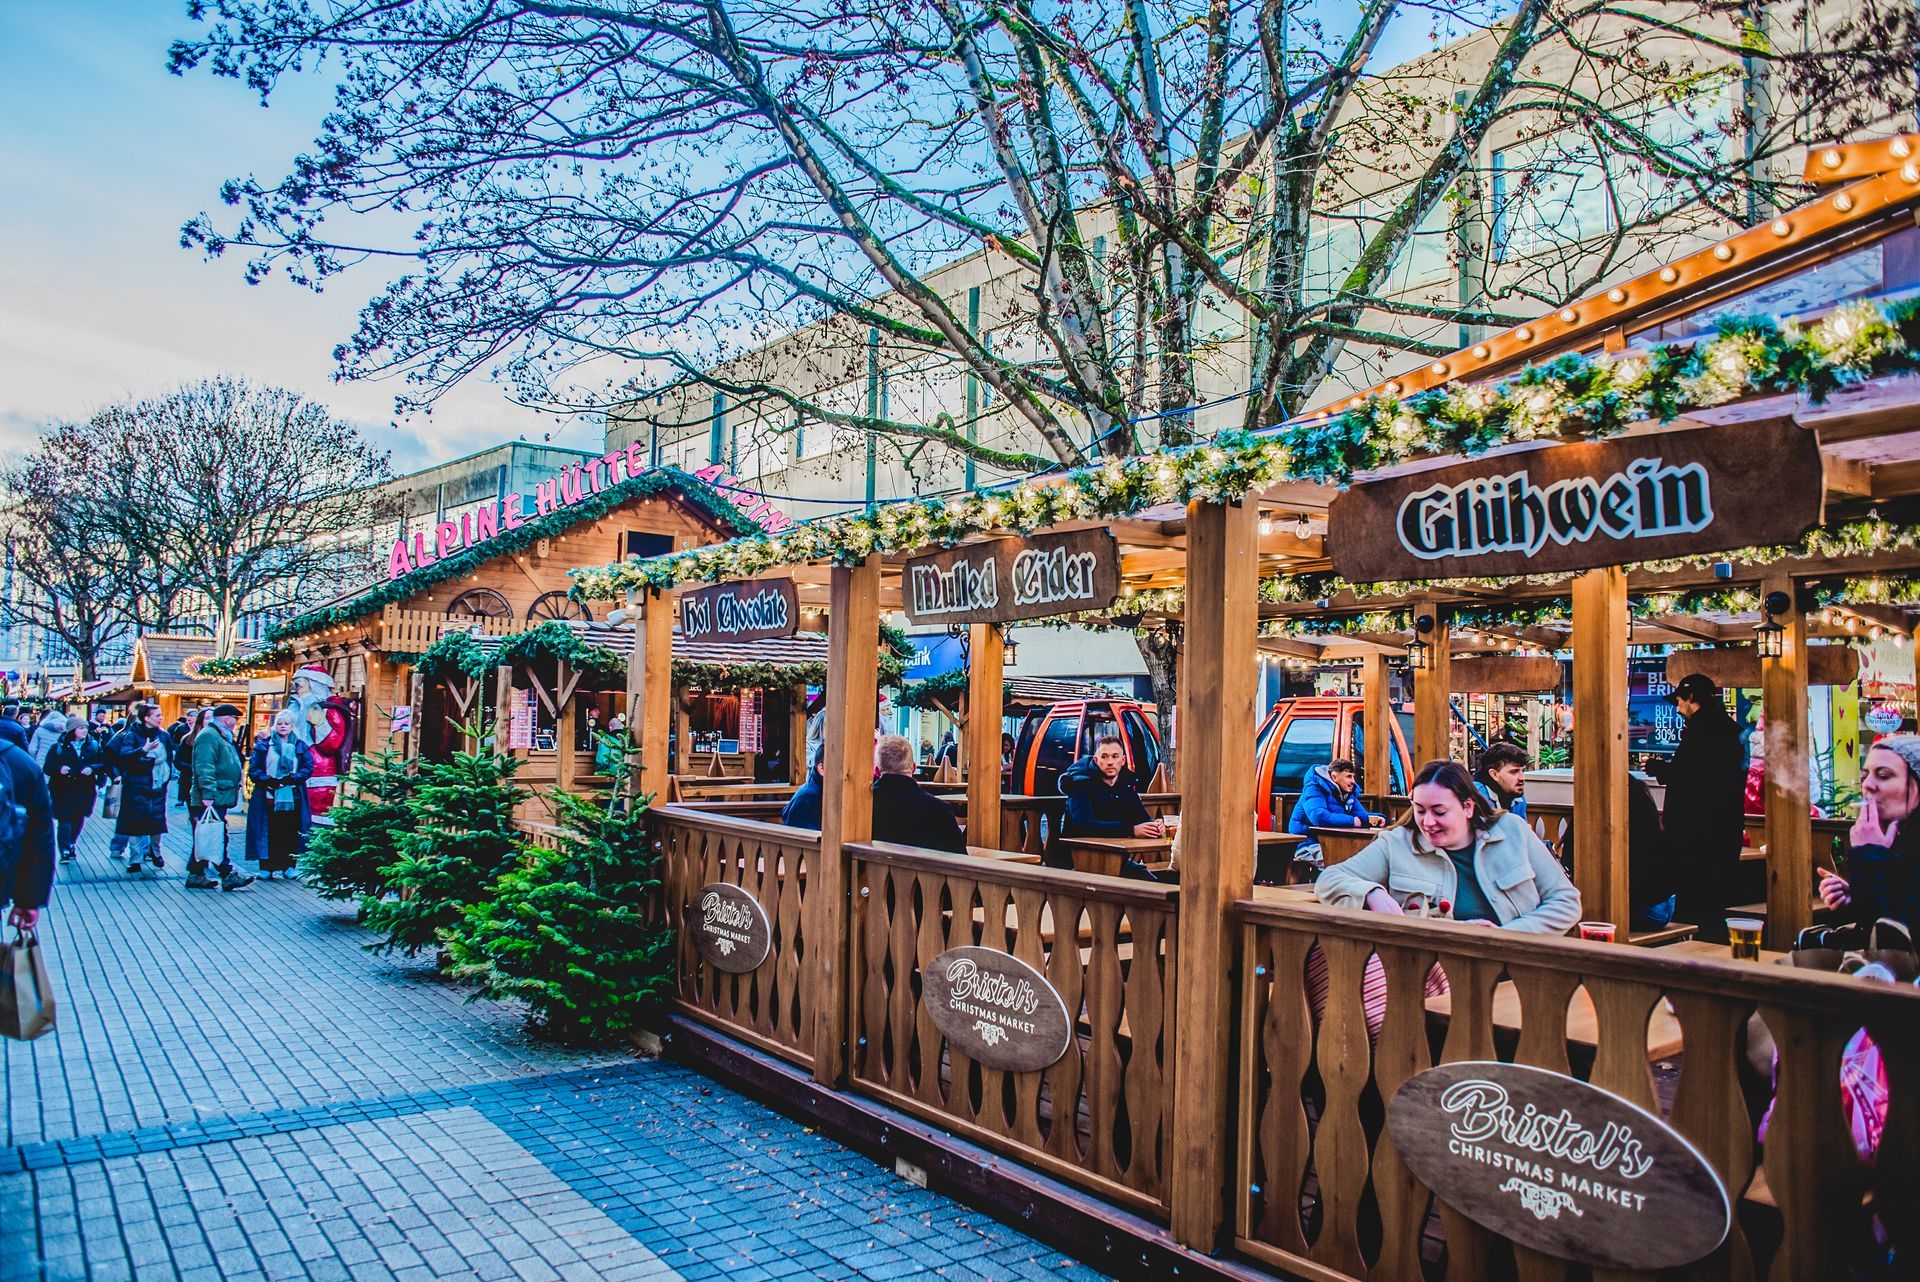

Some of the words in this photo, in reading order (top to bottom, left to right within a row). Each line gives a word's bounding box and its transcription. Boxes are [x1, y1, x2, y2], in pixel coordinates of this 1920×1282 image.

[388, 493, 525, 580] ALPINE
[536, 441, 645, 517] HÜTTE
[1397, 458, 1714, 560] Glühwein
[912, 557, 999, 616] Mulled
[1012, 545, 1096, 605] Cider
[683, 597, 711, 638] Hot
[716, 589, 788, 635] Chocolate
[1655, 705, 1673, 717] BUY
[1655, 716, 1673, 729] GET
[1655, 728, 1676, 741] 30%
[702, 892, 753, 930] Bristol's
[703, 924, 730, 939] CHRISTMAS
[730, 932, 751, 944] MARKET
[947, 958, 1038, 1015] Bristol's
[950, 999, 997, 1022] CHRISTMAS
[999, 1014, 1035, 1035] MARKET
[1440, 1079, 1653, 1179] Bristol's
[1448, 1140, 1554, 1183] CHRISTMAS
[1561, 1172, 1646, 1212] MARKET
